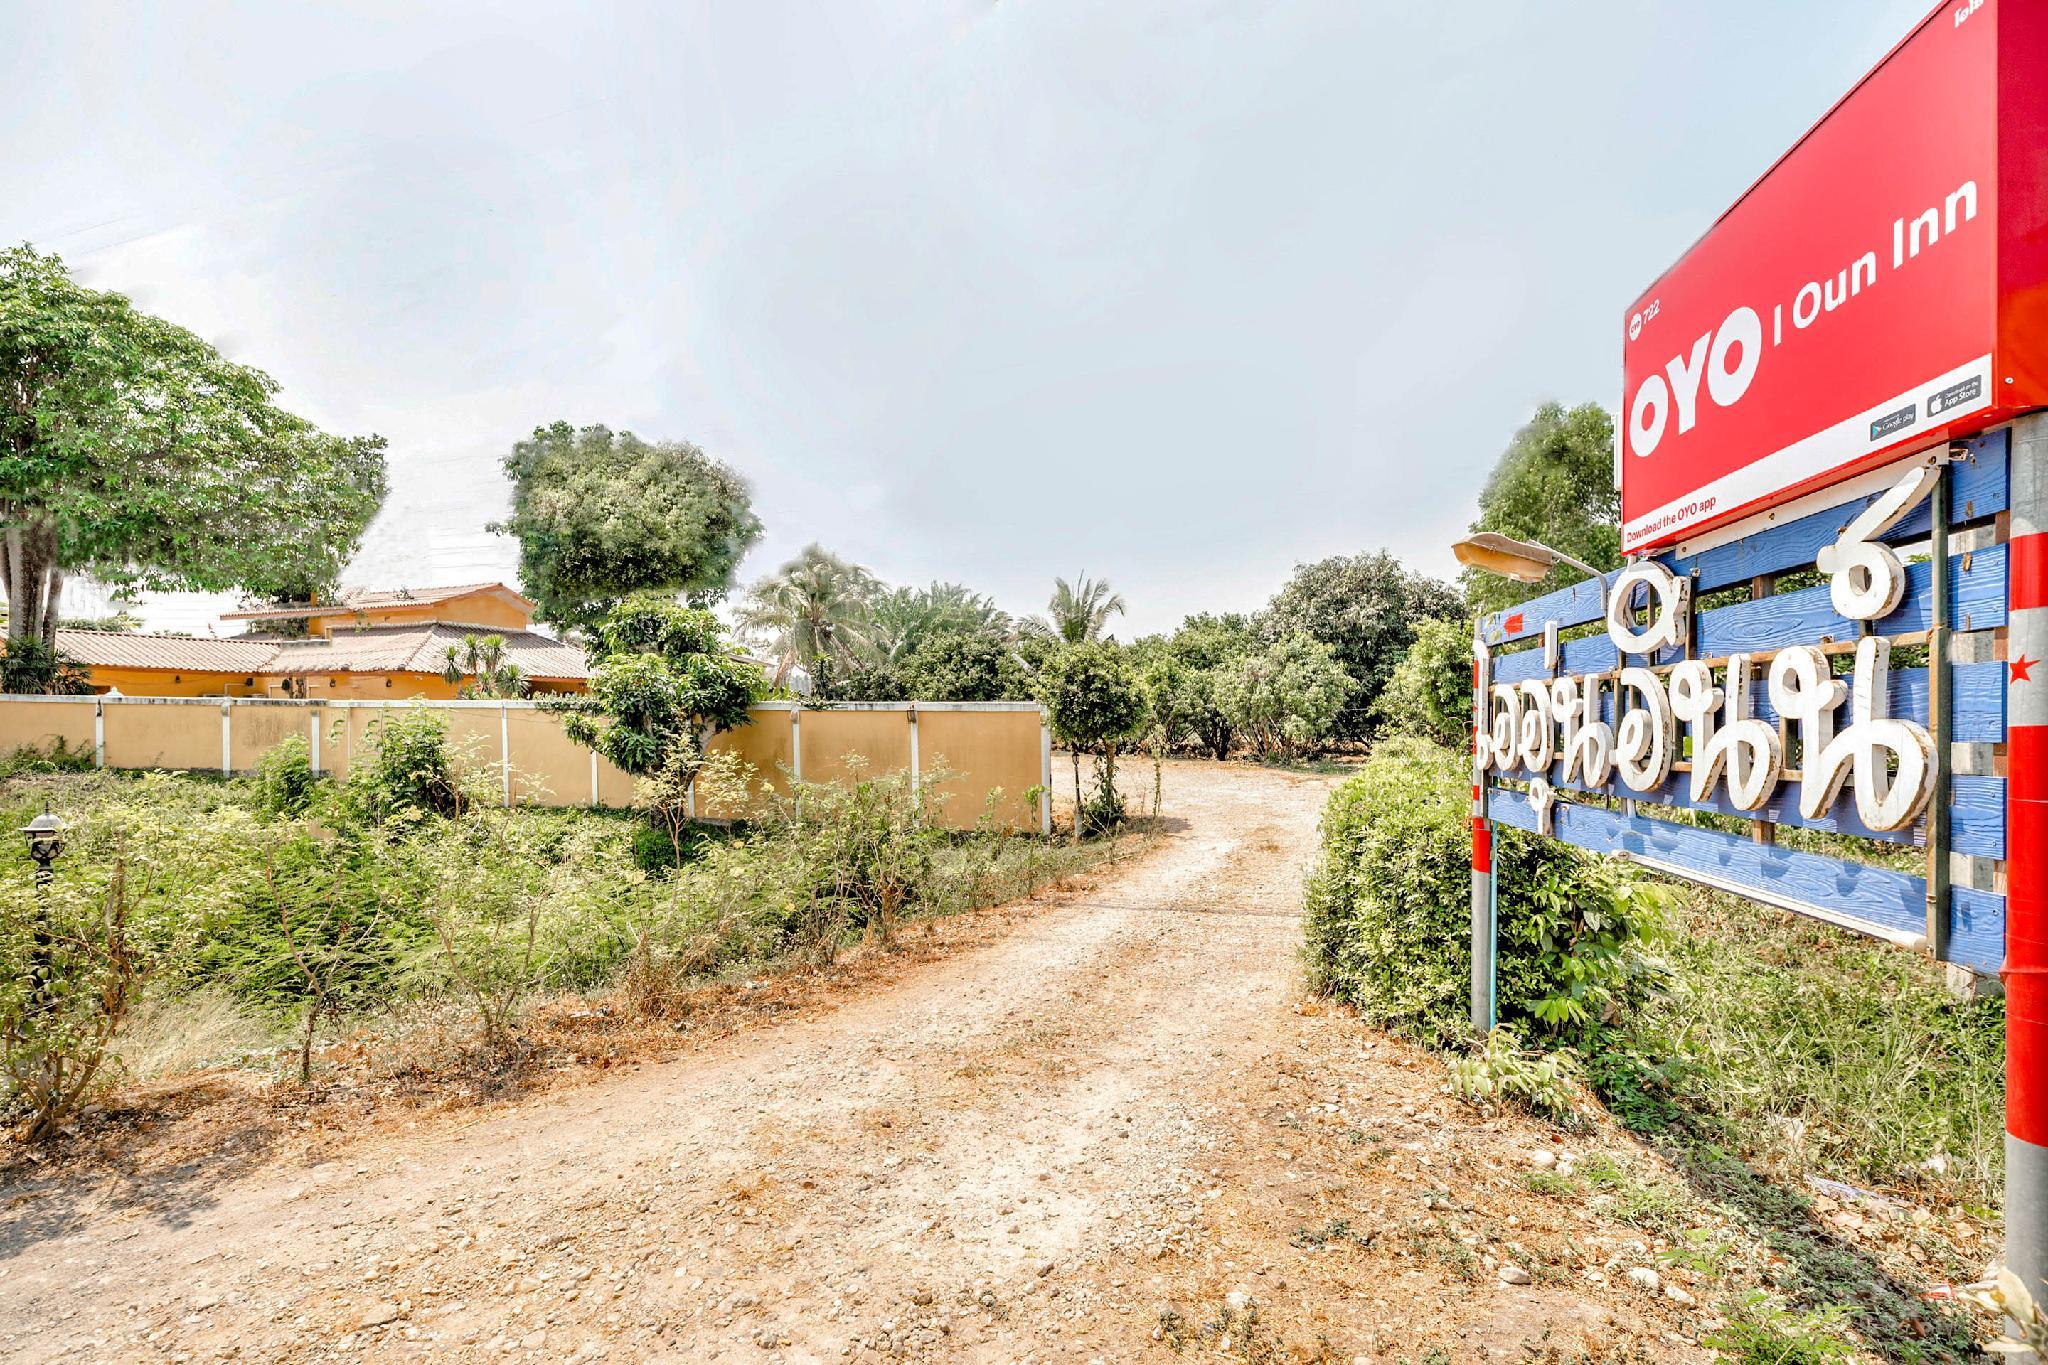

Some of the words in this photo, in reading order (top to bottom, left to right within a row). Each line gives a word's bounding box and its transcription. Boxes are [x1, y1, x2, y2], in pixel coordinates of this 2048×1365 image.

[1629, 306, 1762, 457] OYO
[1792, 251, 1876, 329] Oun
[1893, 180, 1977, 269] Inn
[1643, 299, 1660, 324] 722
[1944, 396, 1958, 407] App
[1959, 388, 1976, 401] Store
[1627, 519, 1662, 542] Download
[1663, 514, 1676, 527] the
[1677, 502, 1697, 521] OYO
[1700, 497, 1717, 512] app
